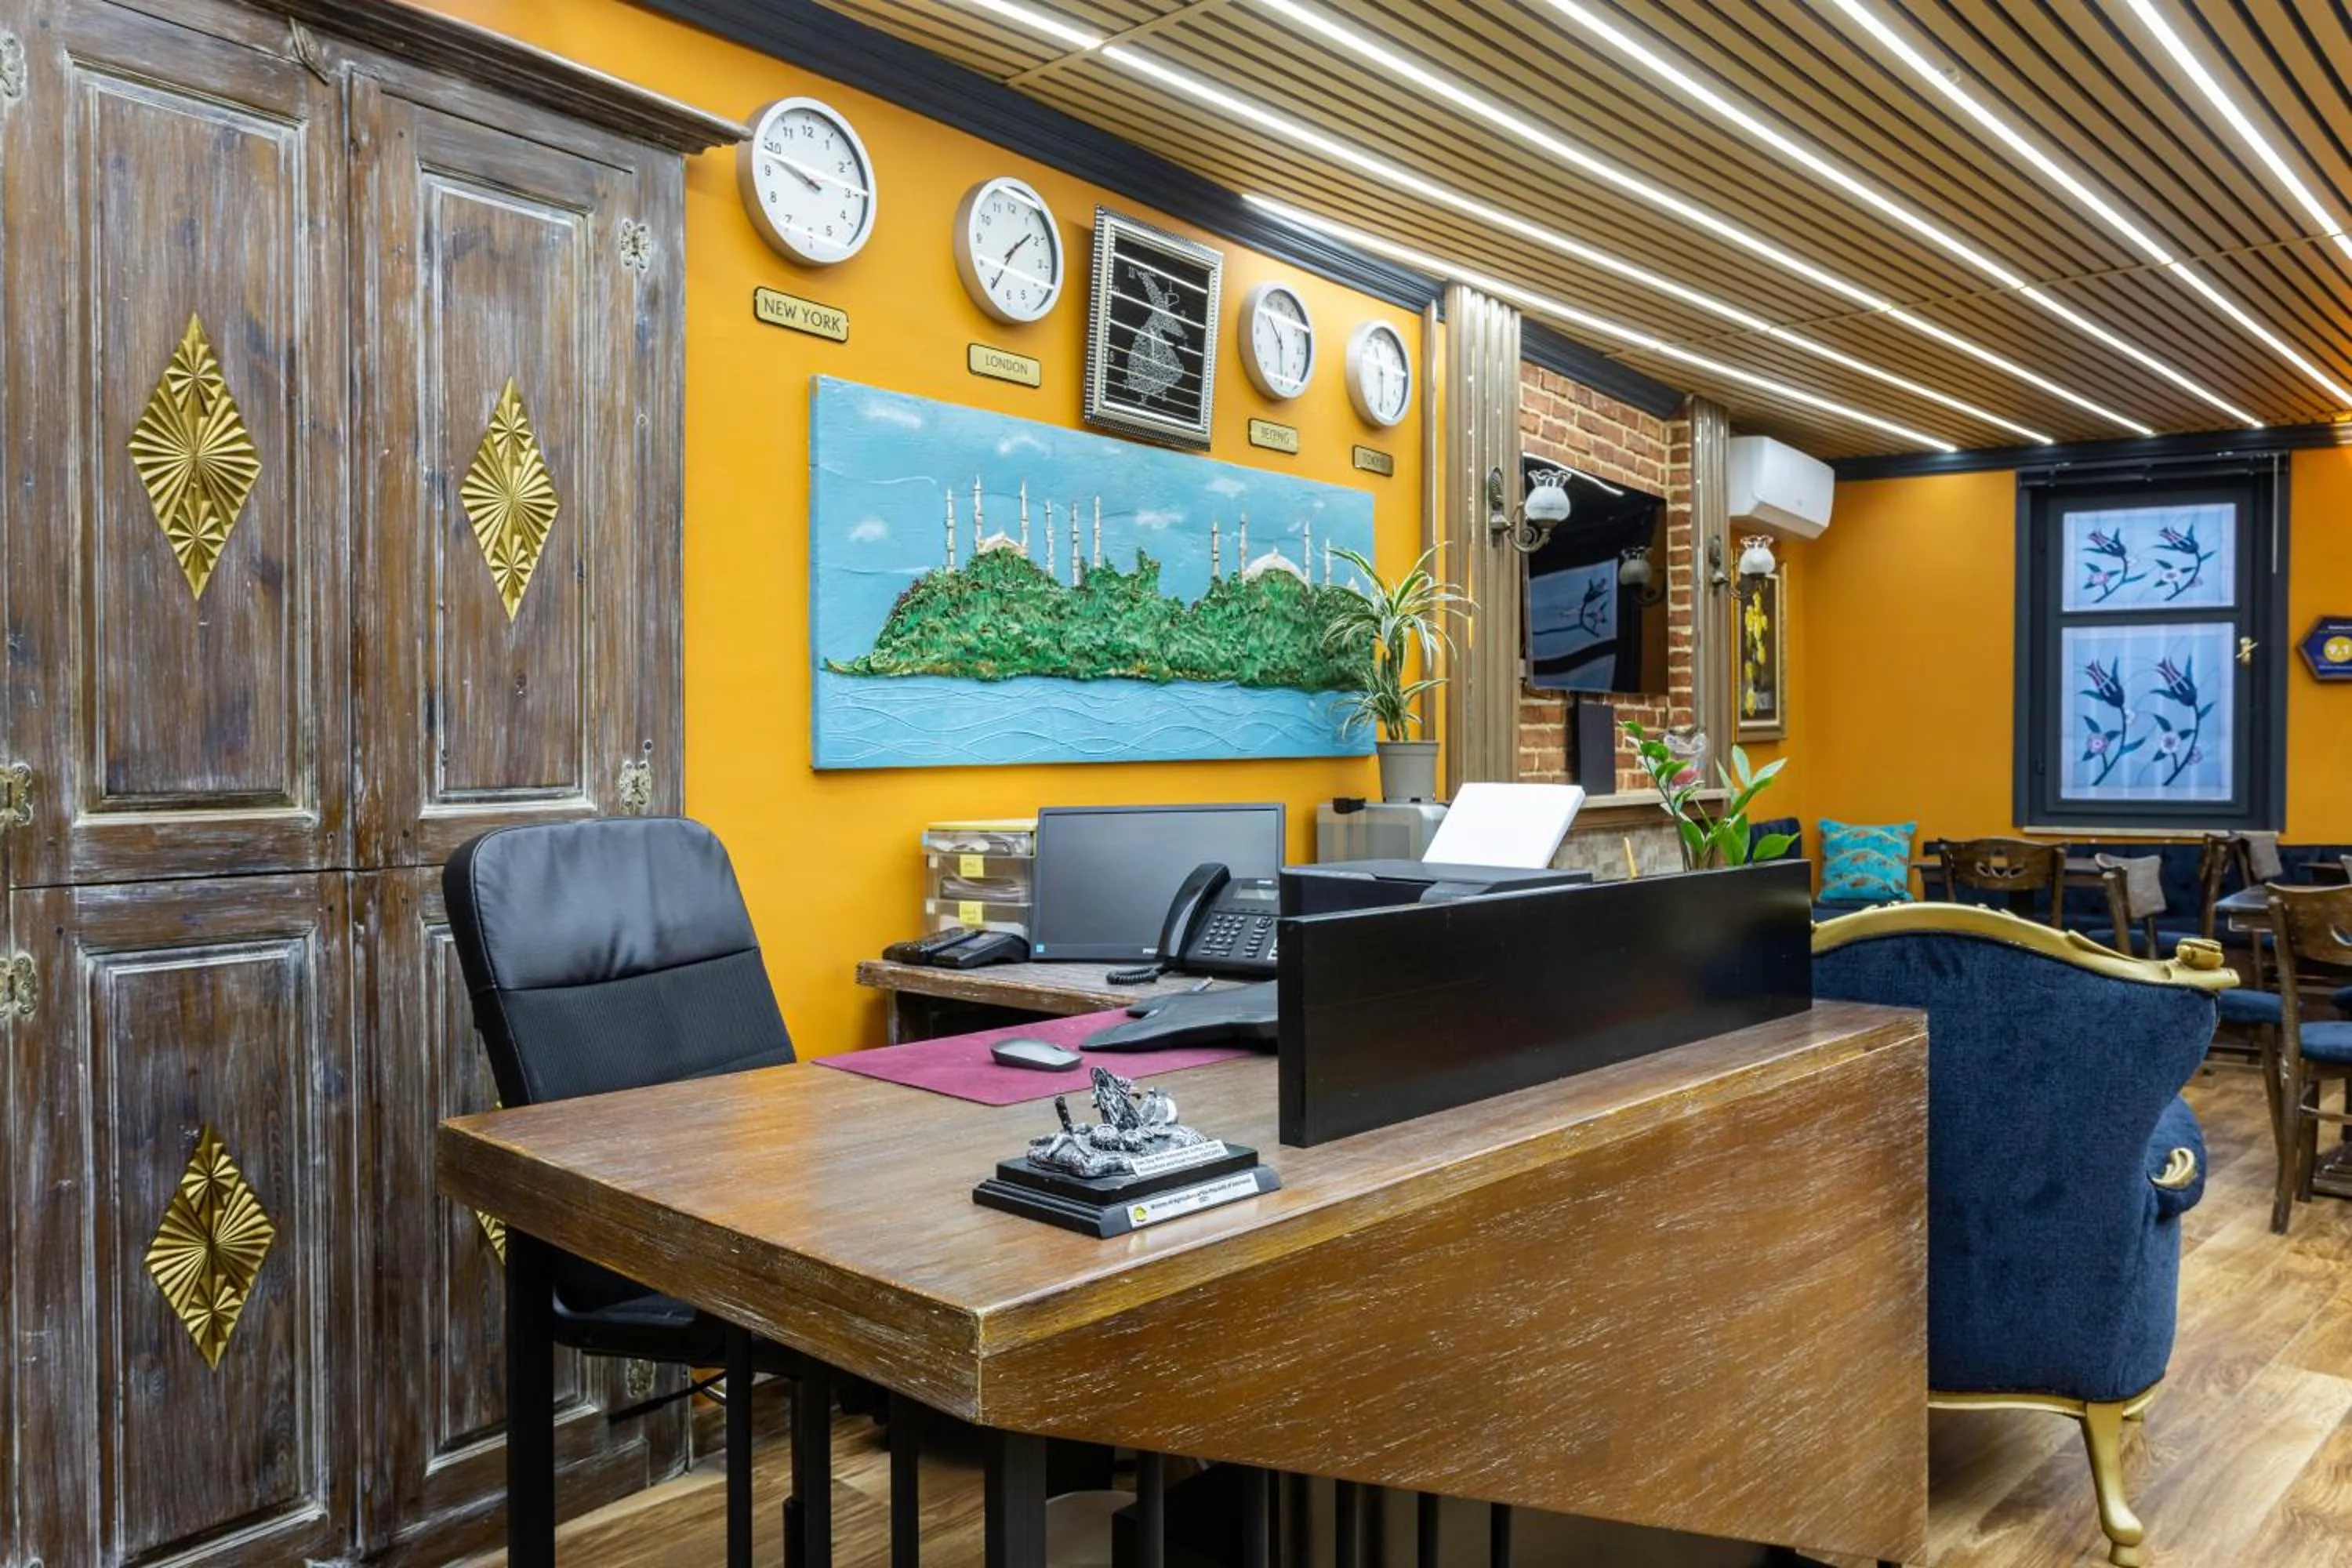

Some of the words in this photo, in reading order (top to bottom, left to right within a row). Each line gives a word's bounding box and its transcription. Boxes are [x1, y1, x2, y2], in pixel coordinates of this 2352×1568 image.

[783, 126, 793, 140] 11
[802, 125, 814, 139] 12
[844, 187, 851, 198] 3
[993, 202, 1002, 213] 11
[1007, 202, 1017, 214] 12
[840, 210, 847, 220] 4
[981, 214, 992, 226] 10
[764, 297, 797, 319] NEW
[802, 307, 840, 332] YORK
[985, 354, 1028, 375] LONDON
